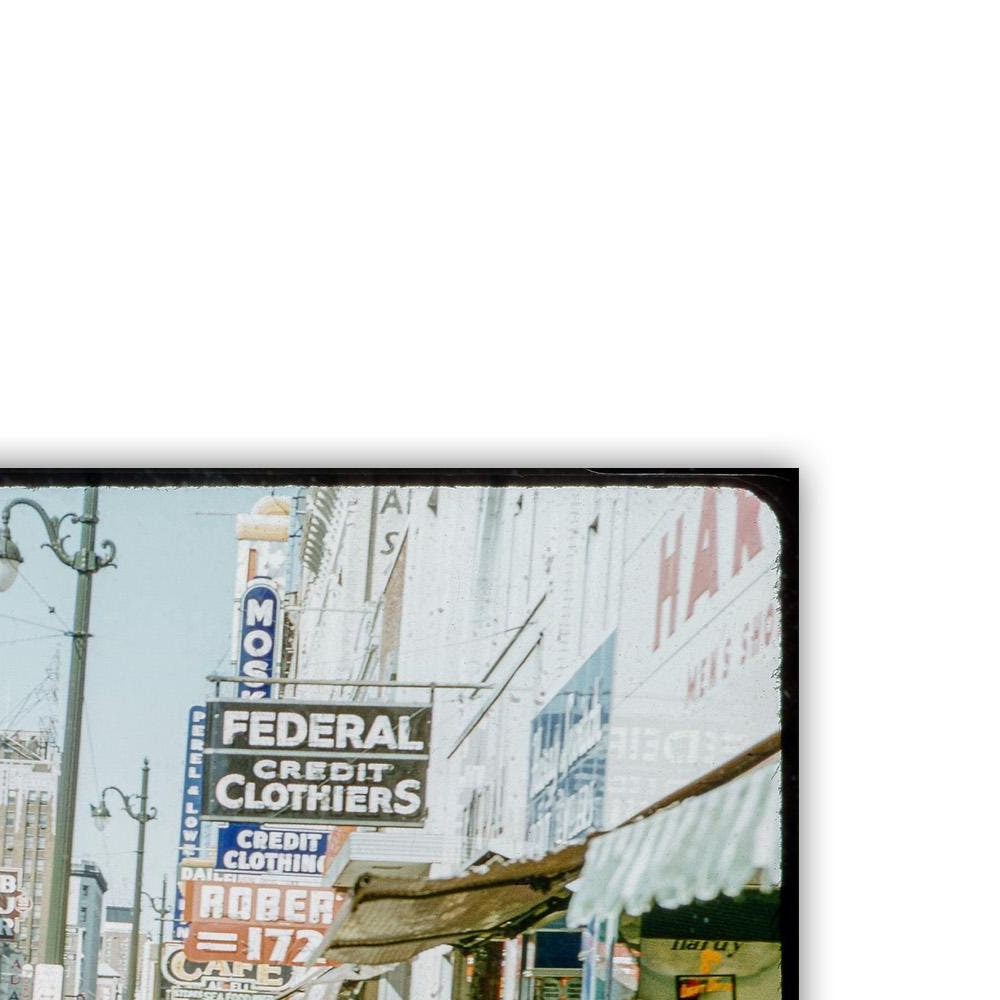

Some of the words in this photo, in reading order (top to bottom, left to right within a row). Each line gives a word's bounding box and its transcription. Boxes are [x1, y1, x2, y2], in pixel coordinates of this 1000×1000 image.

[243, 598, 275, 699] MOS
[222, 710, 424, 751] FEDERAL
[252, 759, 394, 783] CREDIT
[214, 773, 421, 816] CLOTHIERS
[236, 829, 322, 852] CREDIT
[170, 949, 284, 986] CAFE
